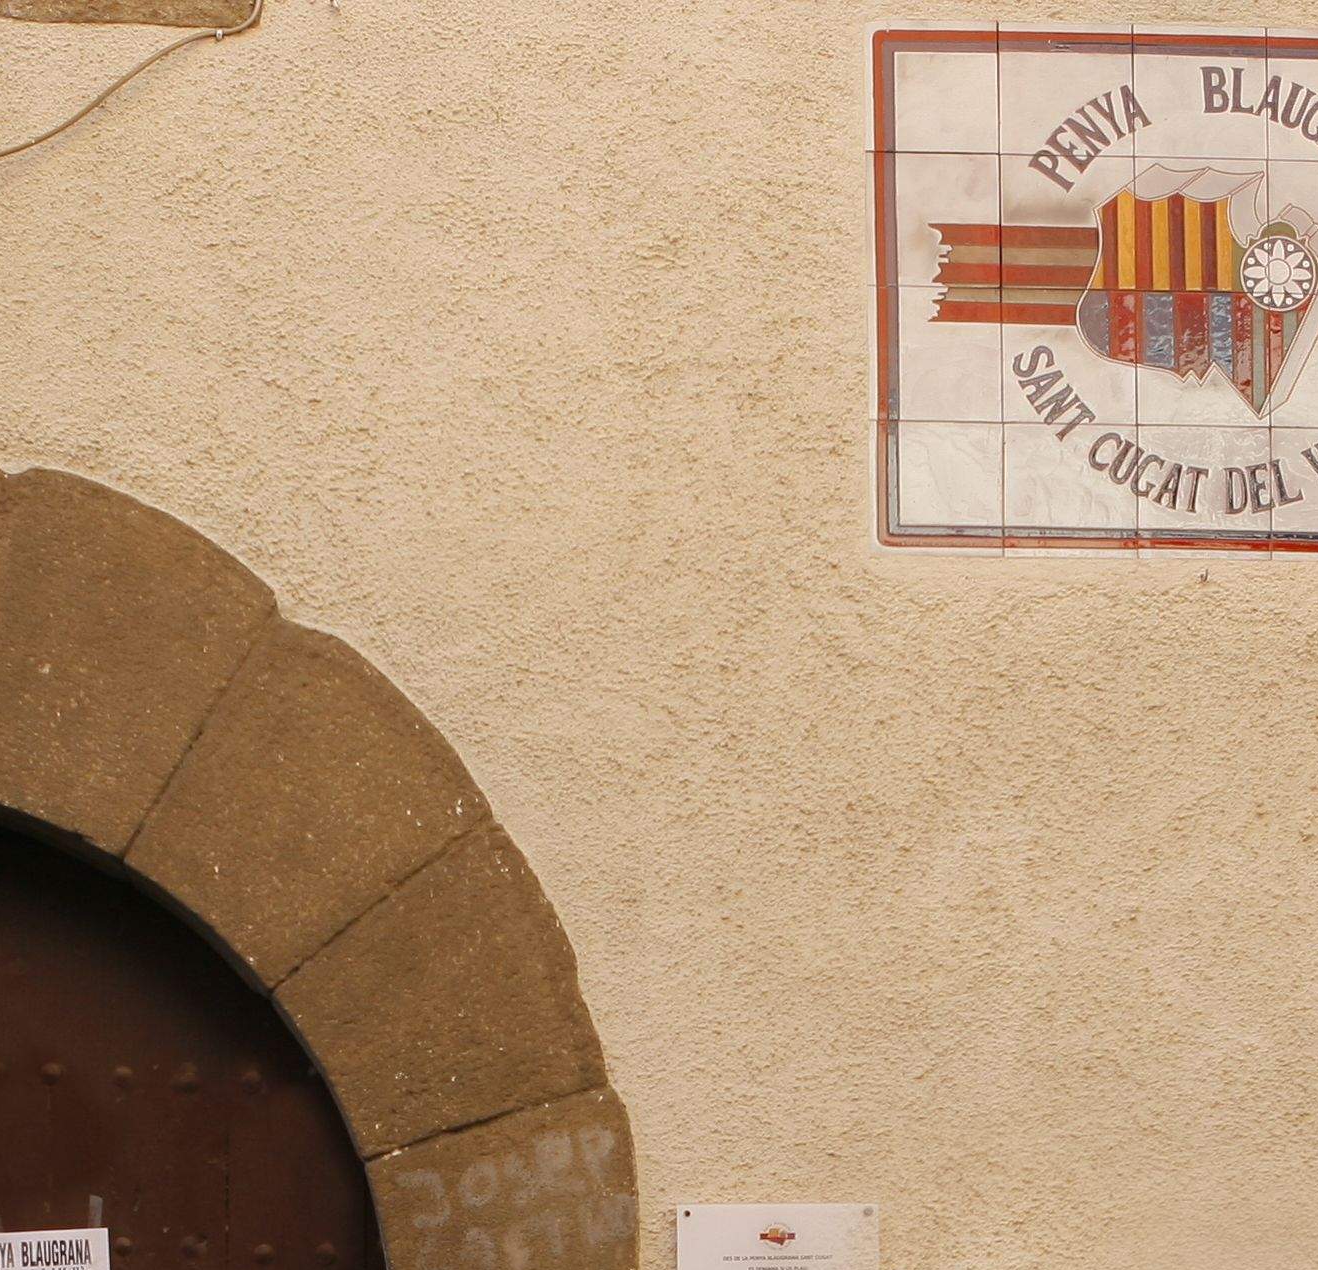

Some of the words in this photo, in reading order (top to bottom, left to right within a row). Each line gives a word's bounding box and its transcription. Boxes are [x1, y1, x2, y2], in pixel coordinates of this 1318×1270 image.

[1028, 84, 1152, 192] PENYA
[1012, 345, 1096, 441] SANT
[1088, 431, 1209, 514] CUGAT
[1225, 457, 1303, 515] DEL
[21, 1239, 92, 1268] BLAUGRANA
